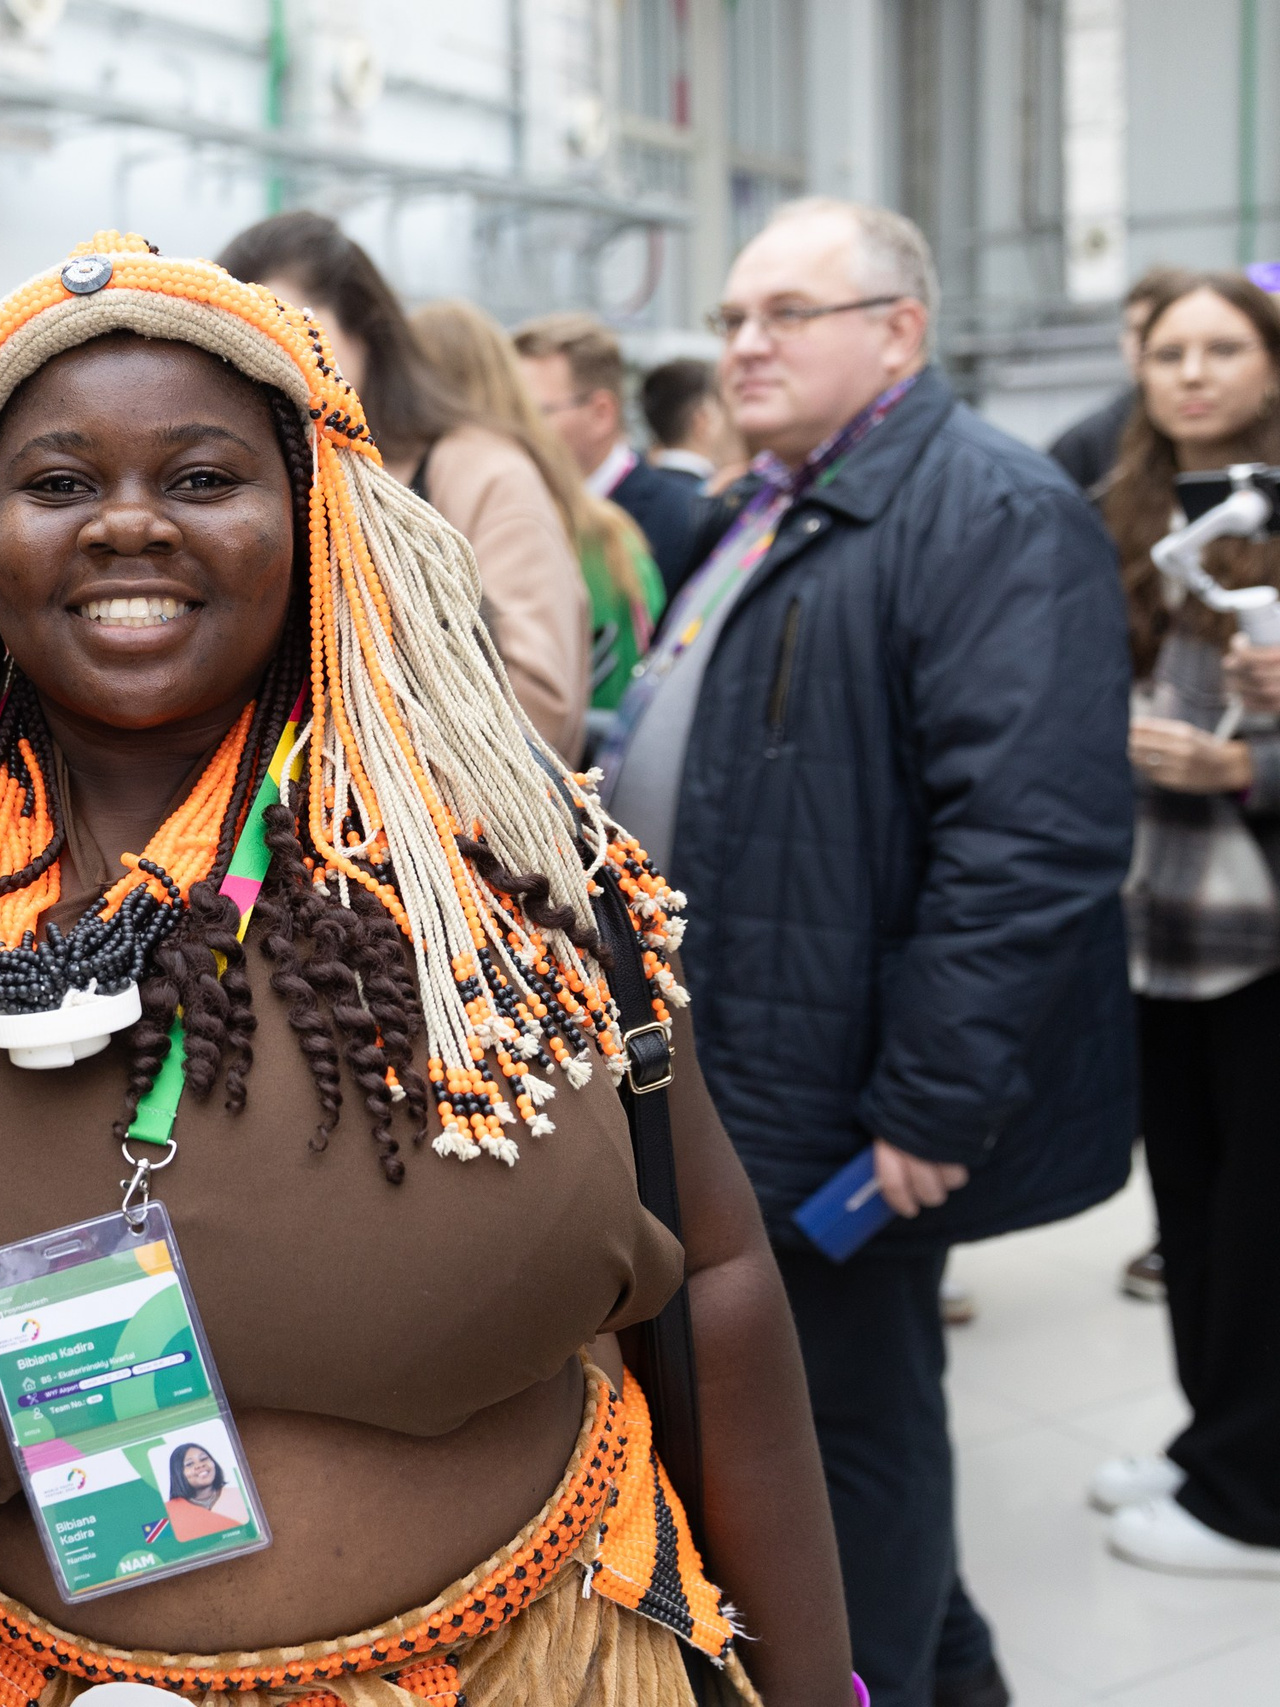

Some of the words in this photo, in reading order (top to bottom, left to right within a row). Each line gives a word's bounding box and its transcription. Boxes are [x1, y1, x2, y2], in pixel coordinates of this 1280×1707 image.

[18, 1352, 57, 1370] Bibiana
[59, 1342, 94, 1358] Kadira
[50, 1402, 71, 1414] Team
[56, 1515, 96, 1533] Bibiana
[60, 1529, 94, 1545] Kadira
[68, 1552, 96, 1565] Namibia
[120, 1554, 155, 1573] NAM
